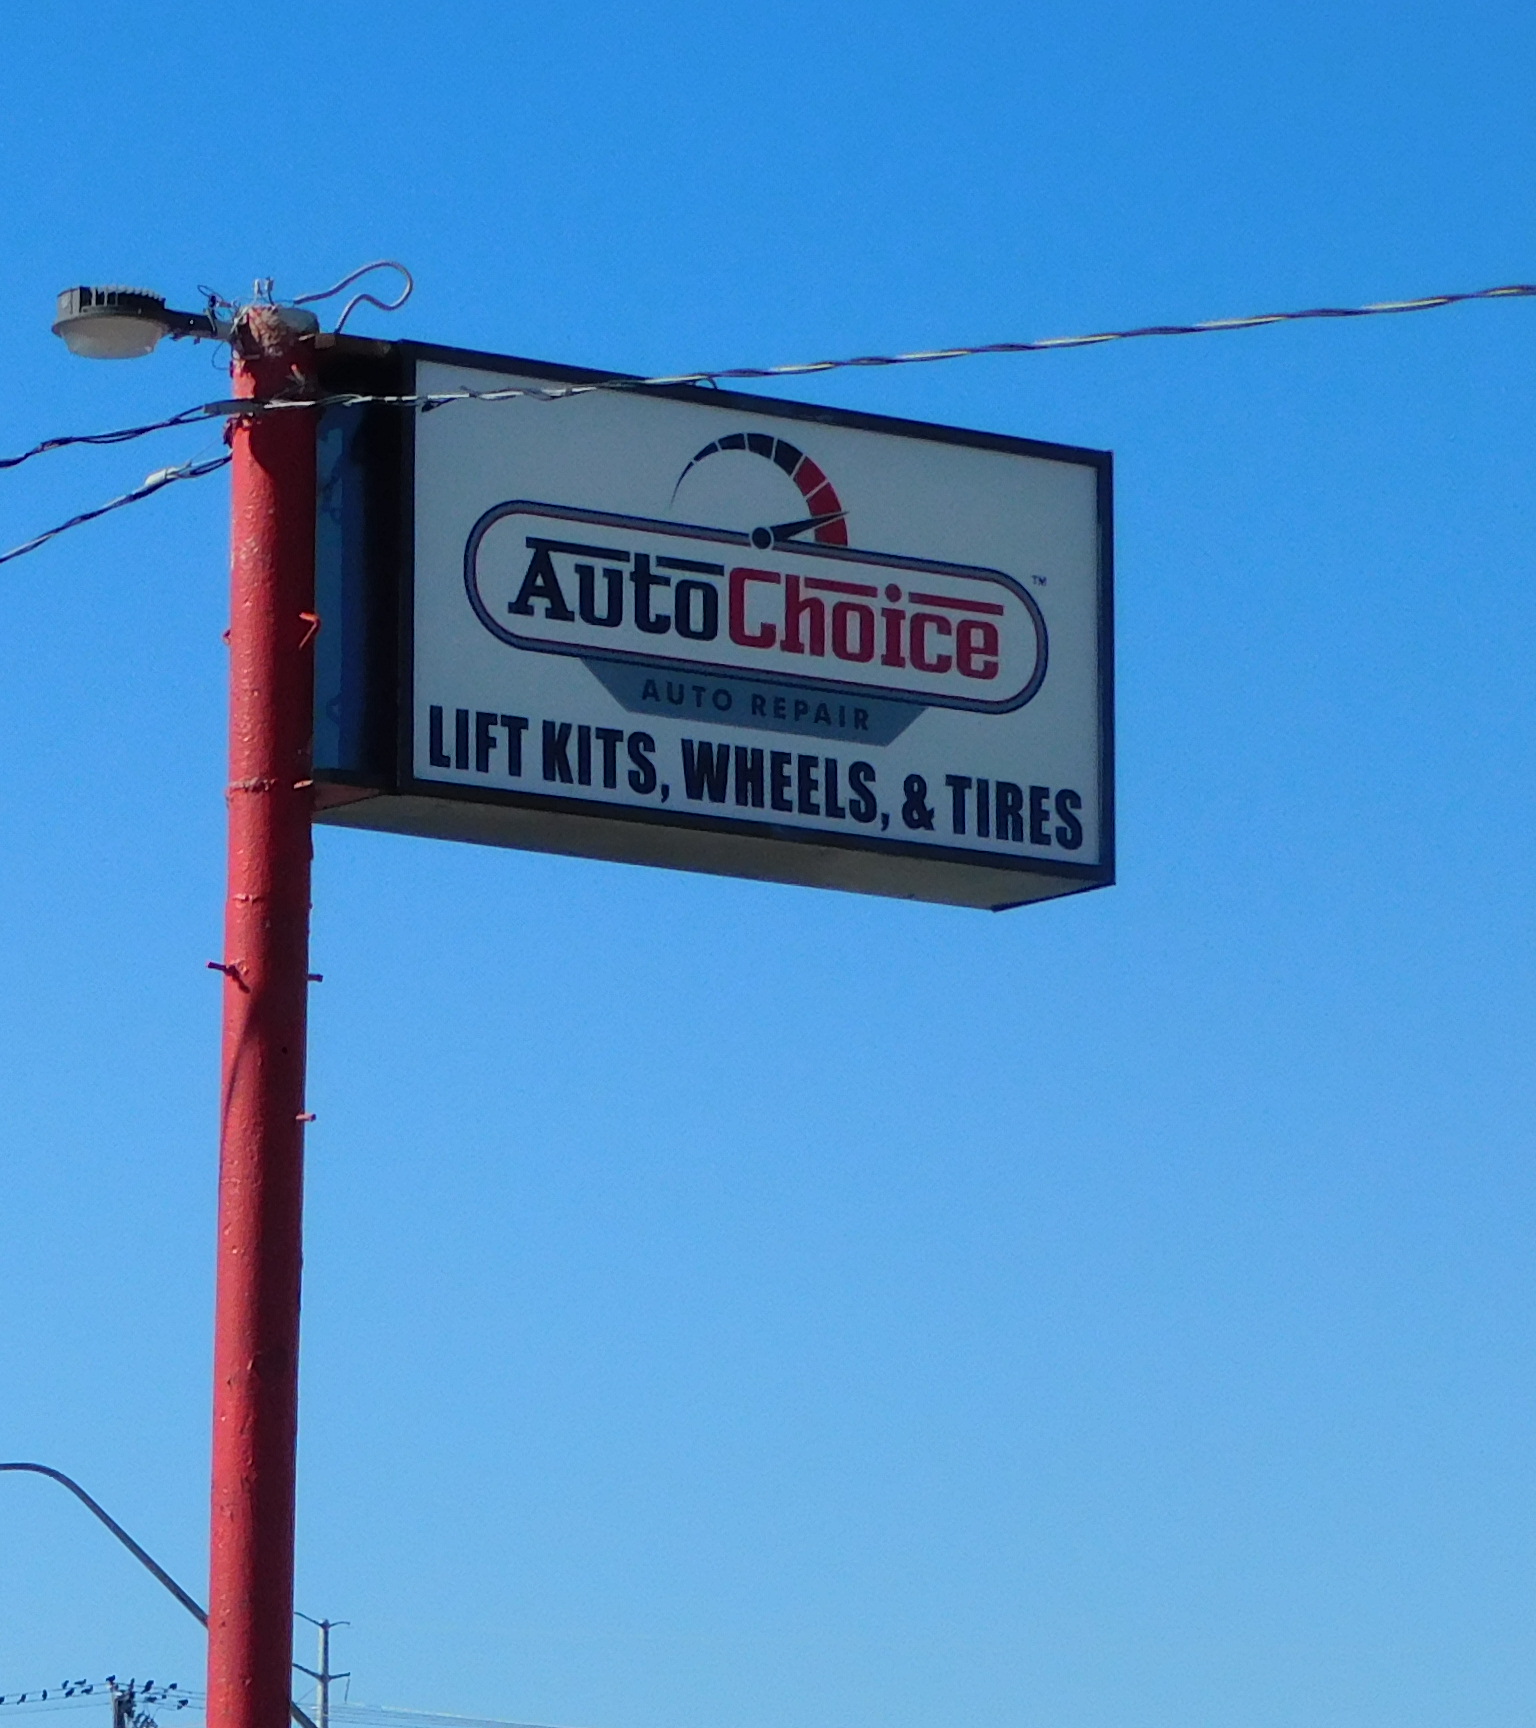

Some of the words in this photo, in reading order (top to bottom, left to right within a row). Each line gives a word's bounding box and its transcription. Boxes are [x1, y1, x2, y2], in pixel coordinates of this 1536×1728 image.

[508, 537, 1005, 681] AutoChoice
[641, 678, 733, 711] AUTO
[751, 694, 871, 732] REPAIR
[428, 705, 528, 778] LIFT
[542, 720, 670, 804] KITS,
[681, 738, 890, 832] WHEELS,
[902, 775, 937, 831] &
[945, 775, 1085, 852] TIRES
